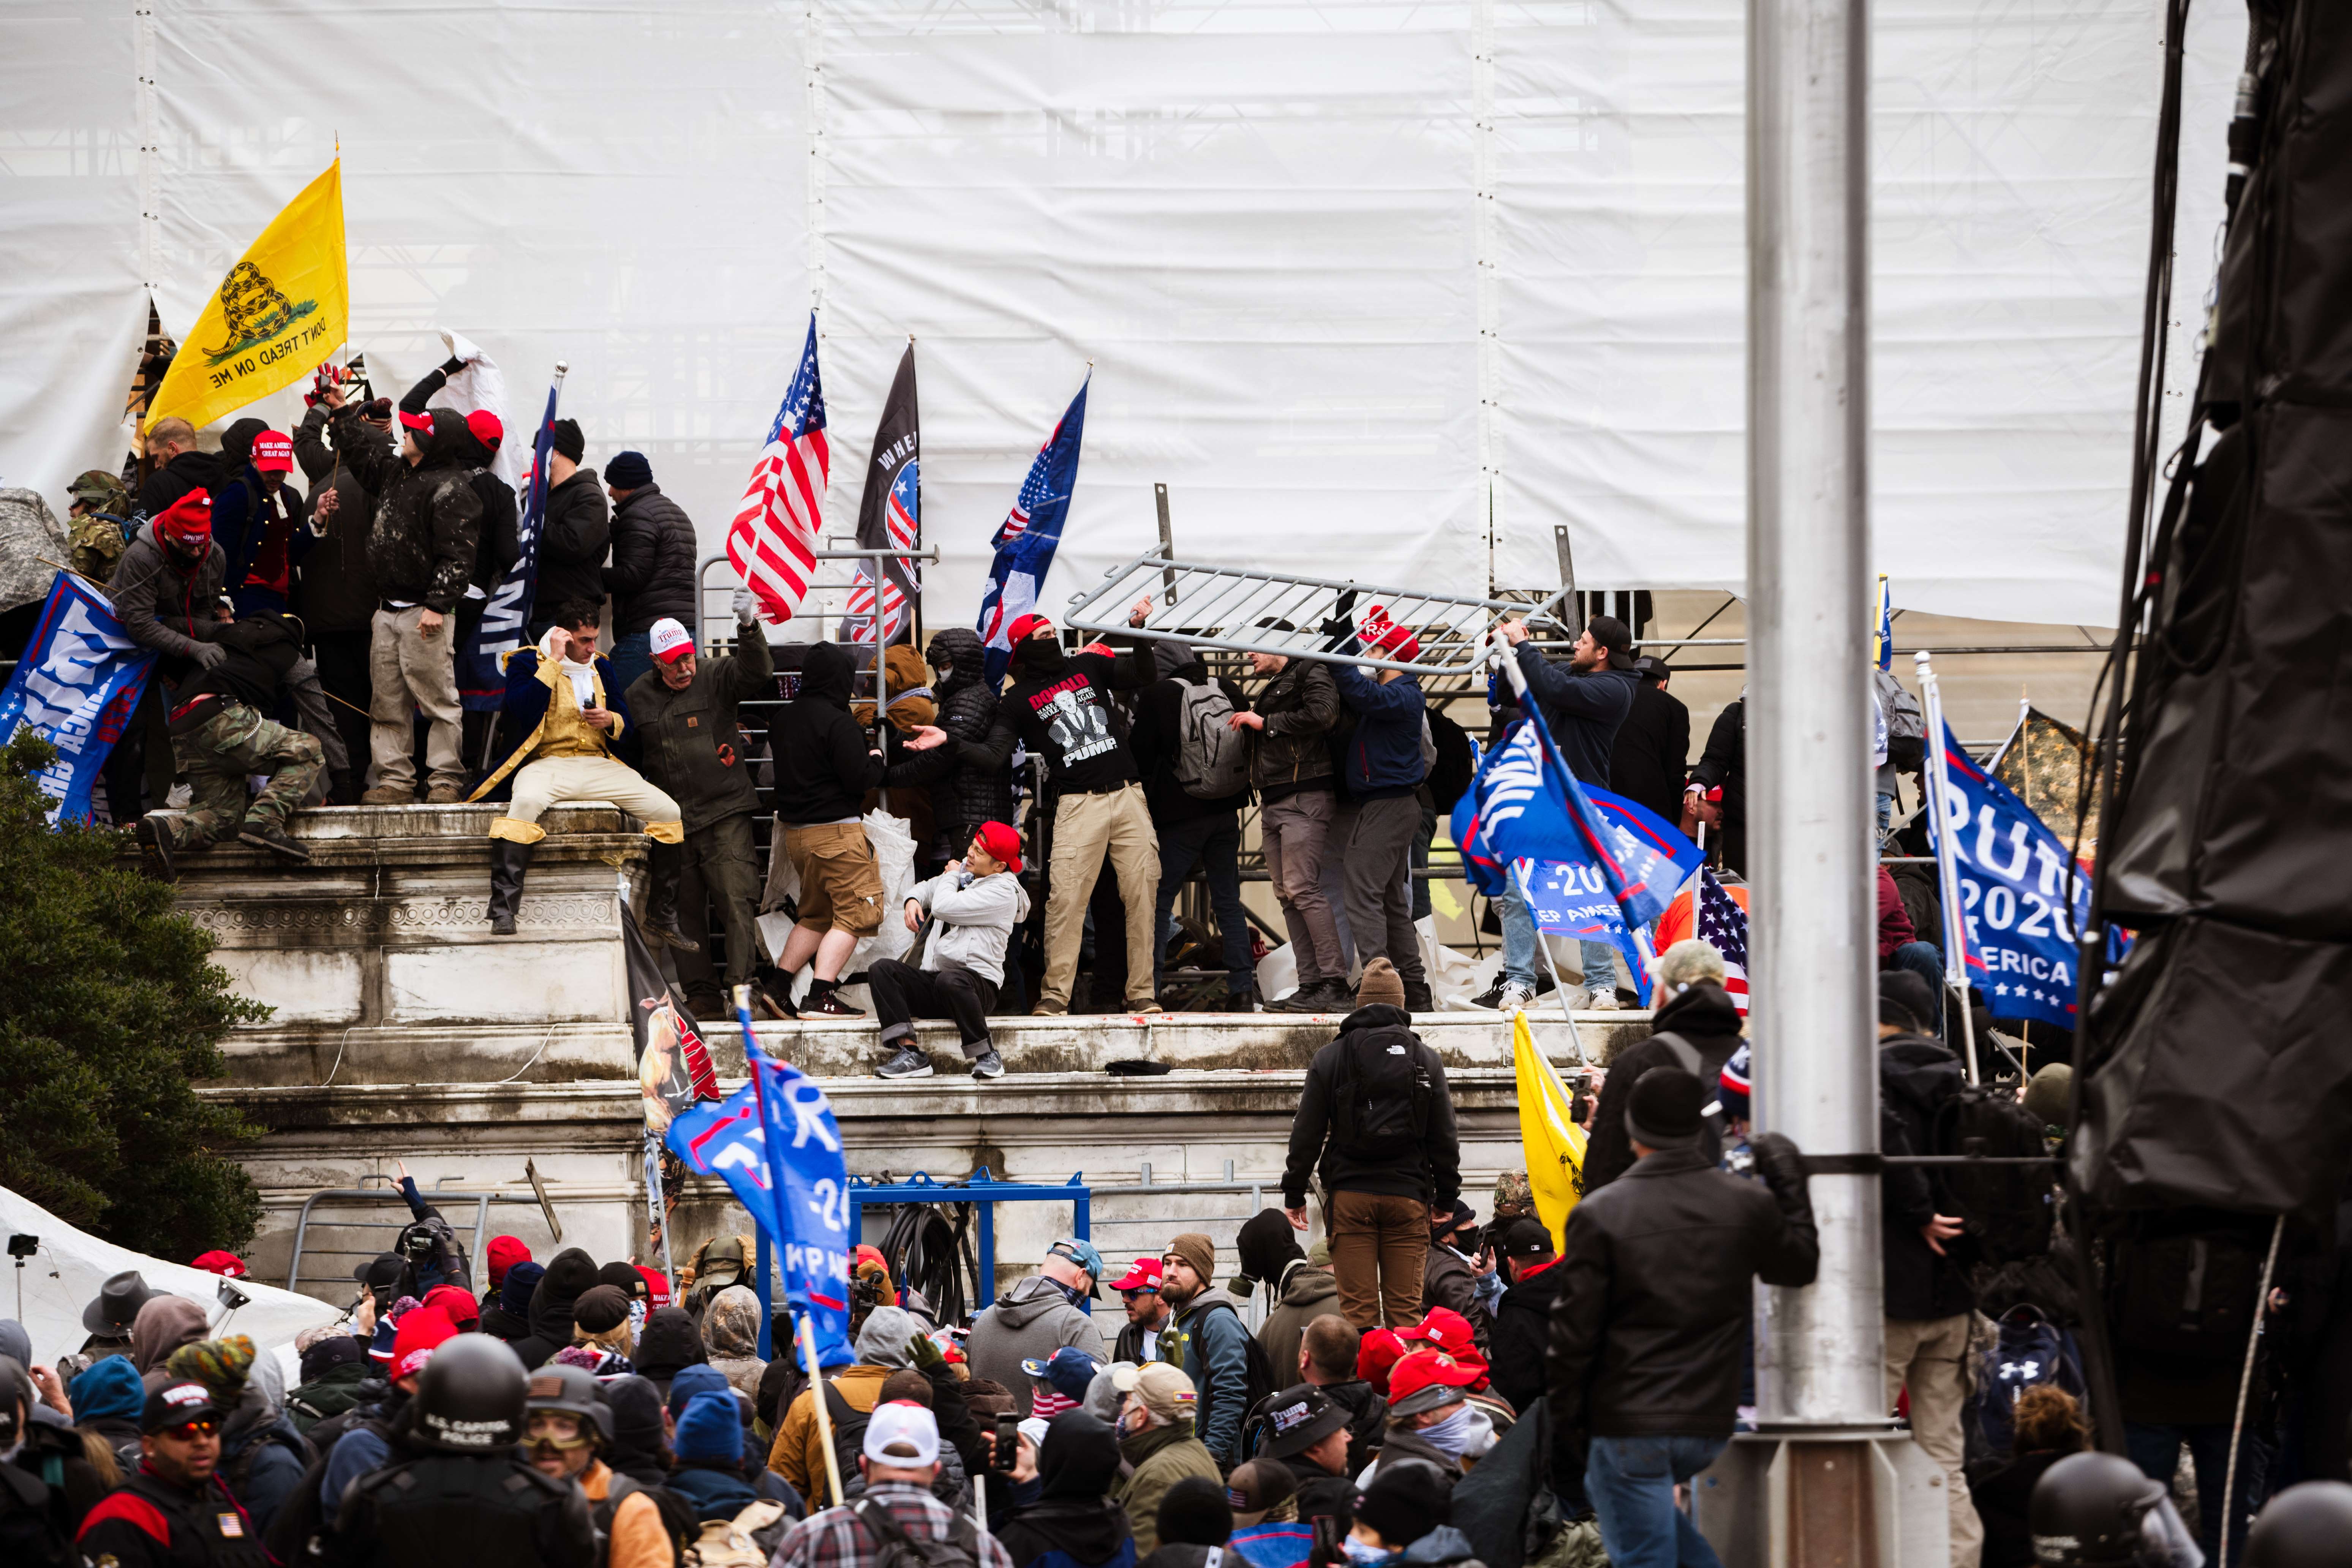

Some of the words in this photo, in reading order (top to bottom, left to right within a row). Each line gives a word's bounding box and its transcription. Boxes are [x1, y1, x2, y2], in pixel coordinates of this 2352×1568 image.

[658, 629, 683, 642] Trump
[1028, 673, 1089, 711] DONALD
[1036, 702, 1056, 716] MAKE
[1076, 686, 1094, 697] AMERICA
[1040, 706, 1059, 722] SWOLE
[1077, 691, 1097, 703] AGAIN
[1063, 737, 1116, 768] PUMP
[1979, 945, 2071, 987] ERICA
[1270, 1401, 1307, 1422] Trump
